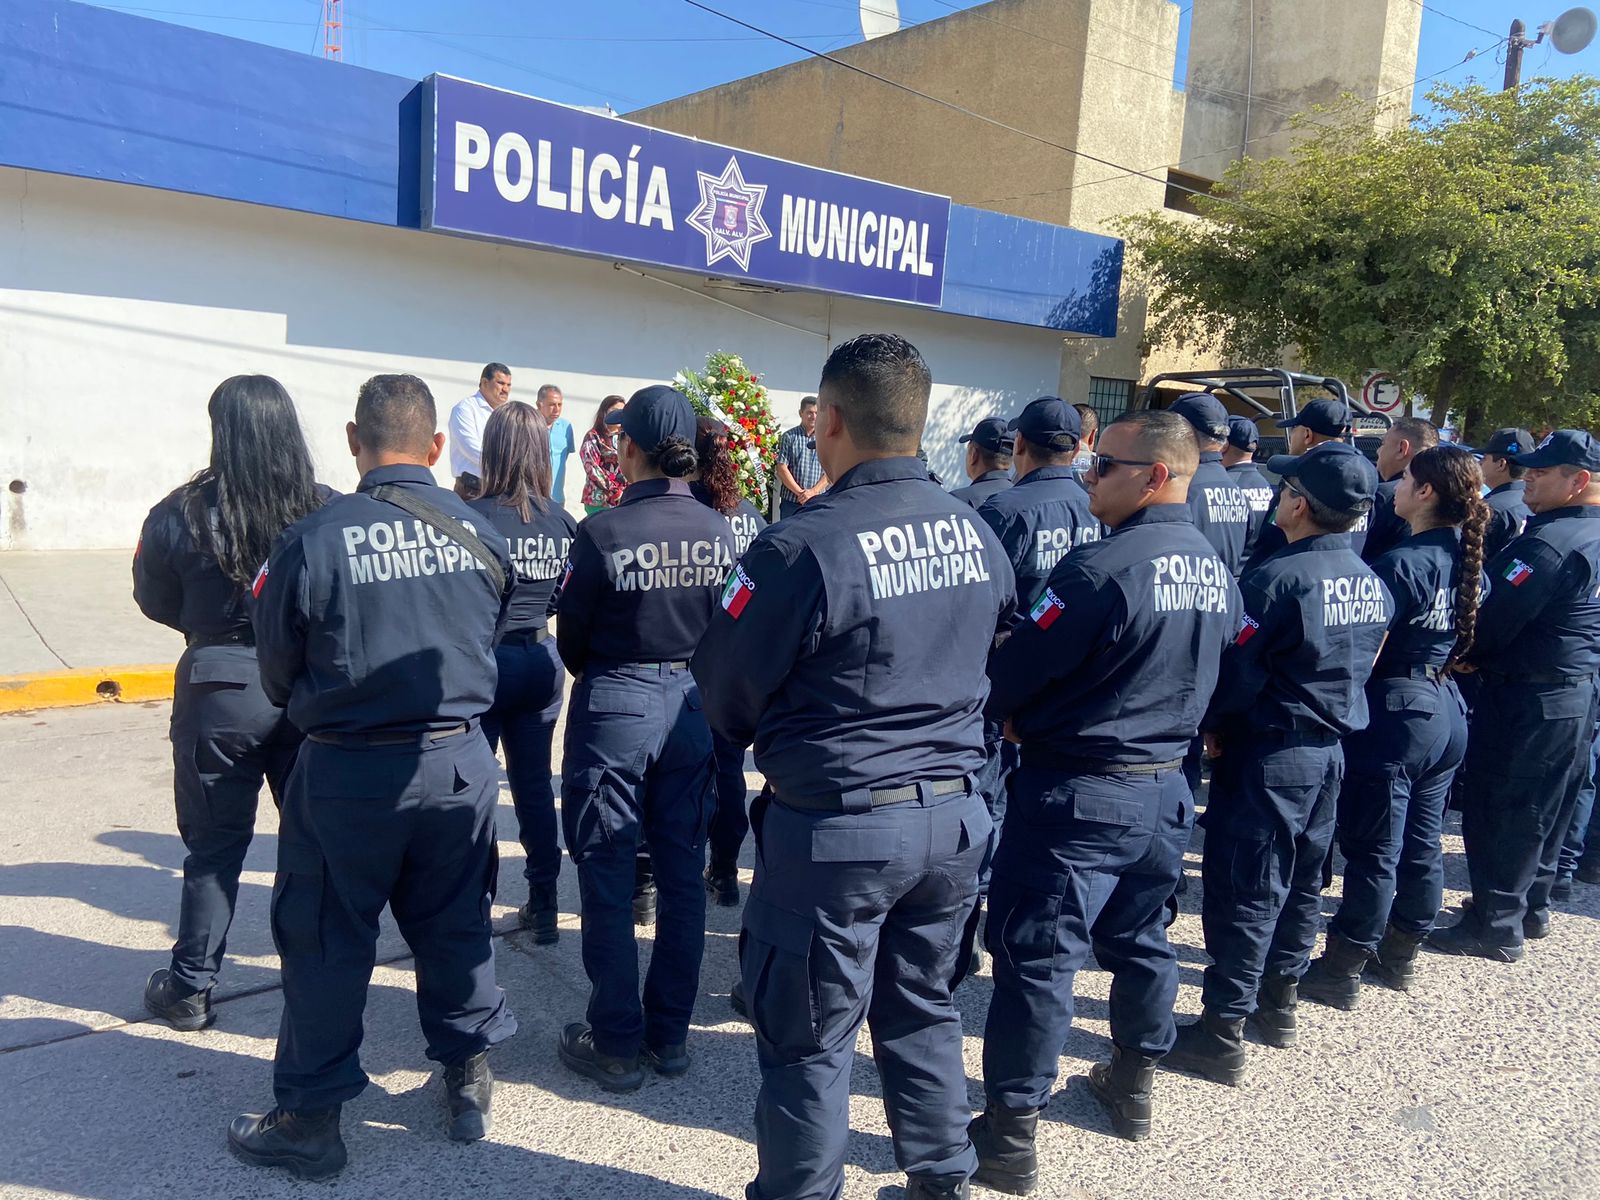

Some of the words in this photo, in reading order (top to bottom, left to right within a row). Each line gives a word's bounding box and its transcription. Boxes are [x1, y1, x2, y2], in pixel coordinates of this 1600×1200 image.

[454, 120, 675, 232] POLICÍA
[778, 193, 935, 277] MUNICIPAL
[1373, 380, 1393, 405] E
[342, 516, 479, 556] POLIC
[506, 533, 557, 560] LICÍA
[611, 535, 734, 576] POLICÍA
[856, 514, 984, 566] POLICÍA
[1036, 523, 1102, 552] POLICÍ
[868, 550, 991, 600] MUNICIPAL
[1150, 554, 1229, 590] POLICÍA
